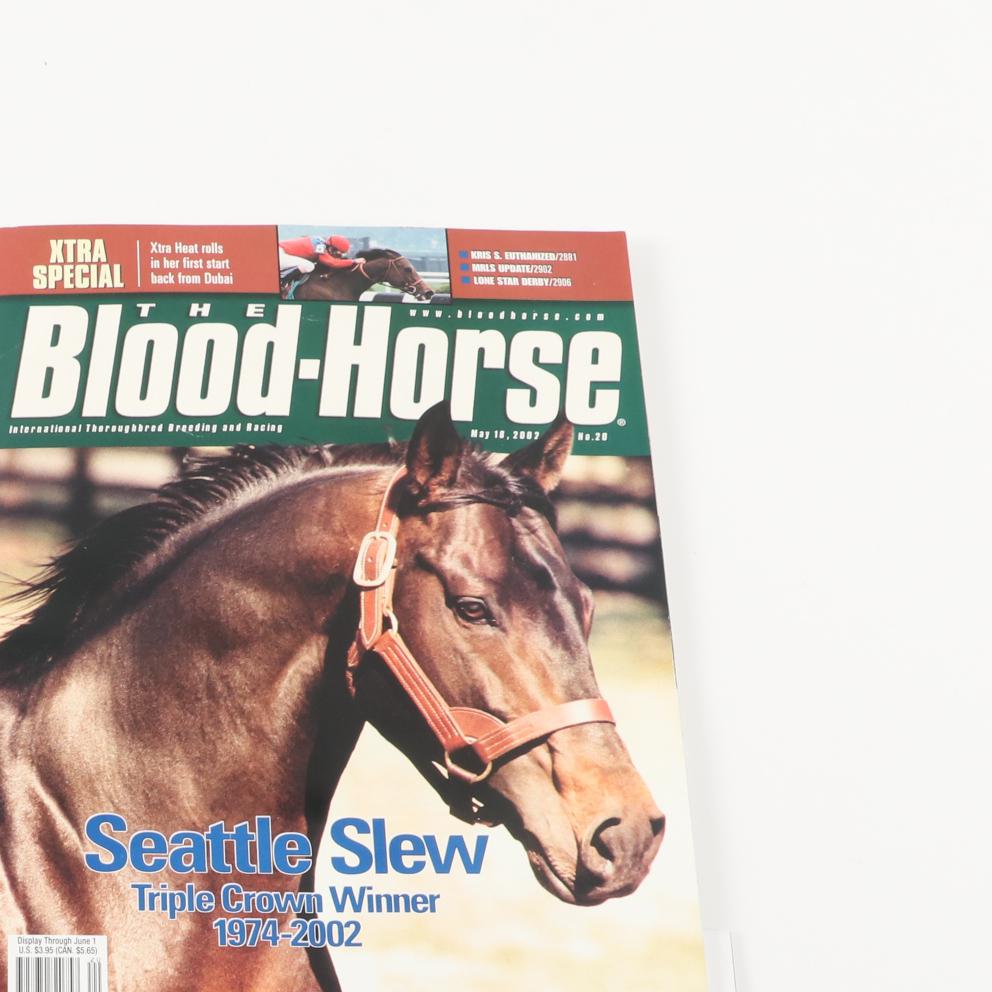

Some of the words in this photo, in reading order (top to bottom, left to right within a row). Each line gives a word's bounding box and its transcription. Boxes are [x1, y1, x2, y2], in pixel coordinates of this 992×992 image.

[49, 238, 107, 263] XTRA
[150, 241, 172, 254] Xtra
[175, 241, 199, 254] Heat
[201, 242, 224, 254] rolls
[470, 250, 492, 260] KRIS
[493, 251, 503, 260] S.
[150, 257, 159, 268] in
[163, 257, 180, 269] her
[183, 257, 203, 269] first
[206, 258, 230, 270] start
[32, 263, 125, 290] SPECIAL
[150, 272, 174, 284] back
[178, 272, 201, 284] from
[205, 272, 233, 285] Dubai
[473, 276, 496, 285] LONE
[496, 276, 520, 286] STAR
[136, 302, 265, 318] THE
[409, 308, 605, 321] www.bloodhorse.com
[10, 304, 622, 425] Blood-Horse
[9, 424, 82, 434] International
[85, 423, 163, 434] Thoroughbred
[168, 423, 218, 433] Breeding
[222, 422, 241, 432] and
[246, 423, 283, 433] Racing
[470, 429, 490, 440] May
[83, 812, 313, 875] Seattle
[330, 816, 489, 875] Slew
[130, 883, 215, 920] Triple
[220, 883, 323, 914] Crown
[328, 885, 440, 914] Winner
[212, 917, 363, 948] 1974-2002
[17, 936, 42, 946] Display
[44, 936, 72, 945] Through
[74, 937, 91, 945] June
